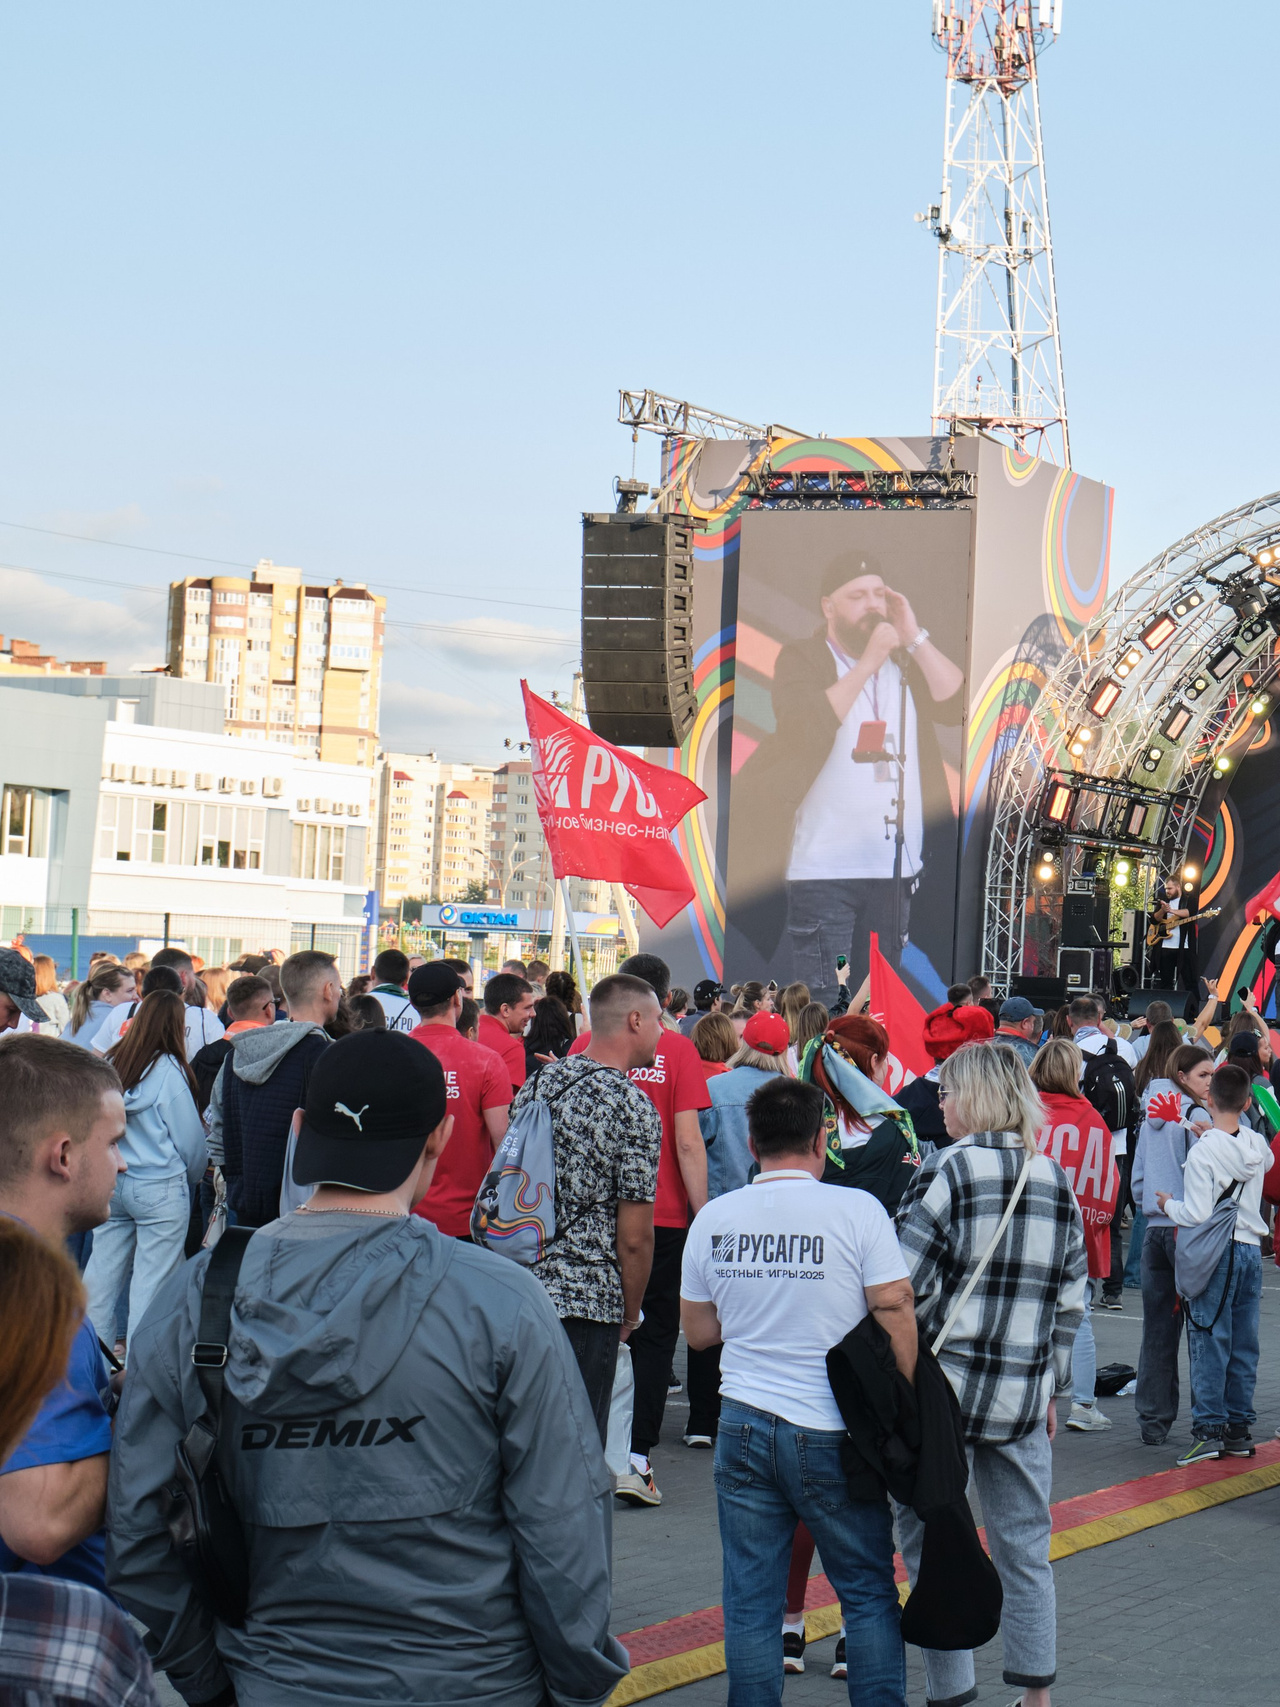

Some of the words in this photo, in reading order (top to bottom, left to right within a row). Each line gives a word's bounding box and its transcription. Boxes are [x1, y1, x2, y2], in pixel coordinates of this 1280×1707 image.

[581, 745, 663, 819] РУС
[460, 911, 518, 926] ОКТАН
[631, 1067, 666, 1084] 2025
[737, 1233, 824, 1265] РУСАГРО
[714, 1268, 764, 1279] ЧЕСТНЫЕ
[767, 1268, 798, 1279] ИГРЫ
[799, 1271, 825, 1280] 2025
[241, 1415, 426, 1450] DEMIX
